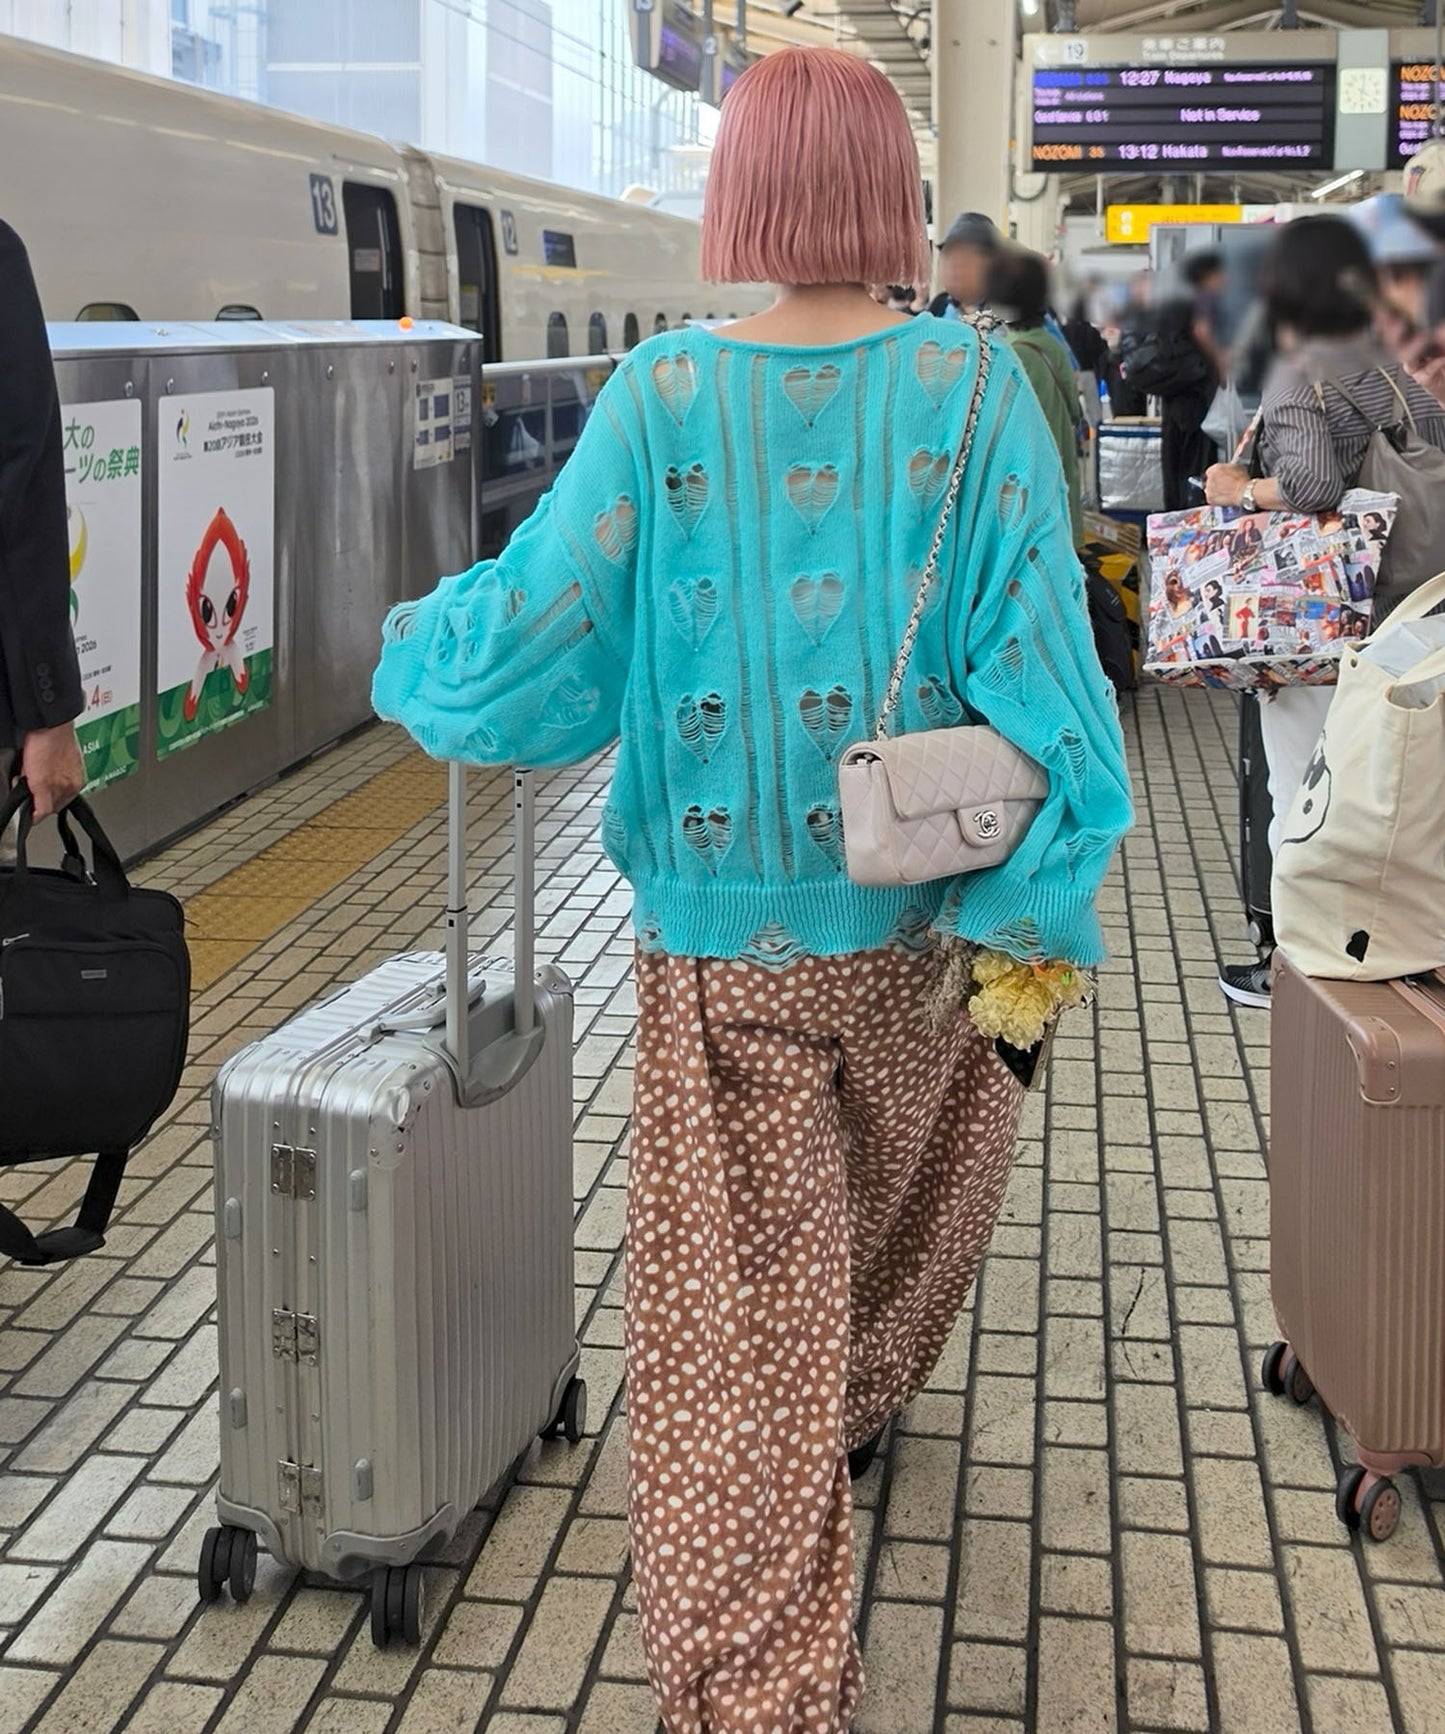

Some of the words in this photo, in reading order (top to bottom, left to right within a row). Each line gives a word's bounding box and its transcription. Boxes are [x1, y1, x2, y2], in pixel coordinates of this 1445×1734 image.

[1119, 70, 1160, 86] 12:27
[1163, 70, 1212, 86] Nagoya
[1401, 64, 1445, 82] NOZO
[1180, 108, 1203, 122] Not
[1203, 108, 1216, 121] in
[1216, 108, 1261, 122] Service
[1032, 144, 1082, 160] NOZOMI
[1118, 144, 1159, 160] 13:12
[1161, 144, 1209, 159] Hakata
[312, 180, 336, 229] 13
[501, 213, 517, 251] 12
[63, 416, 95, 450] 大の
